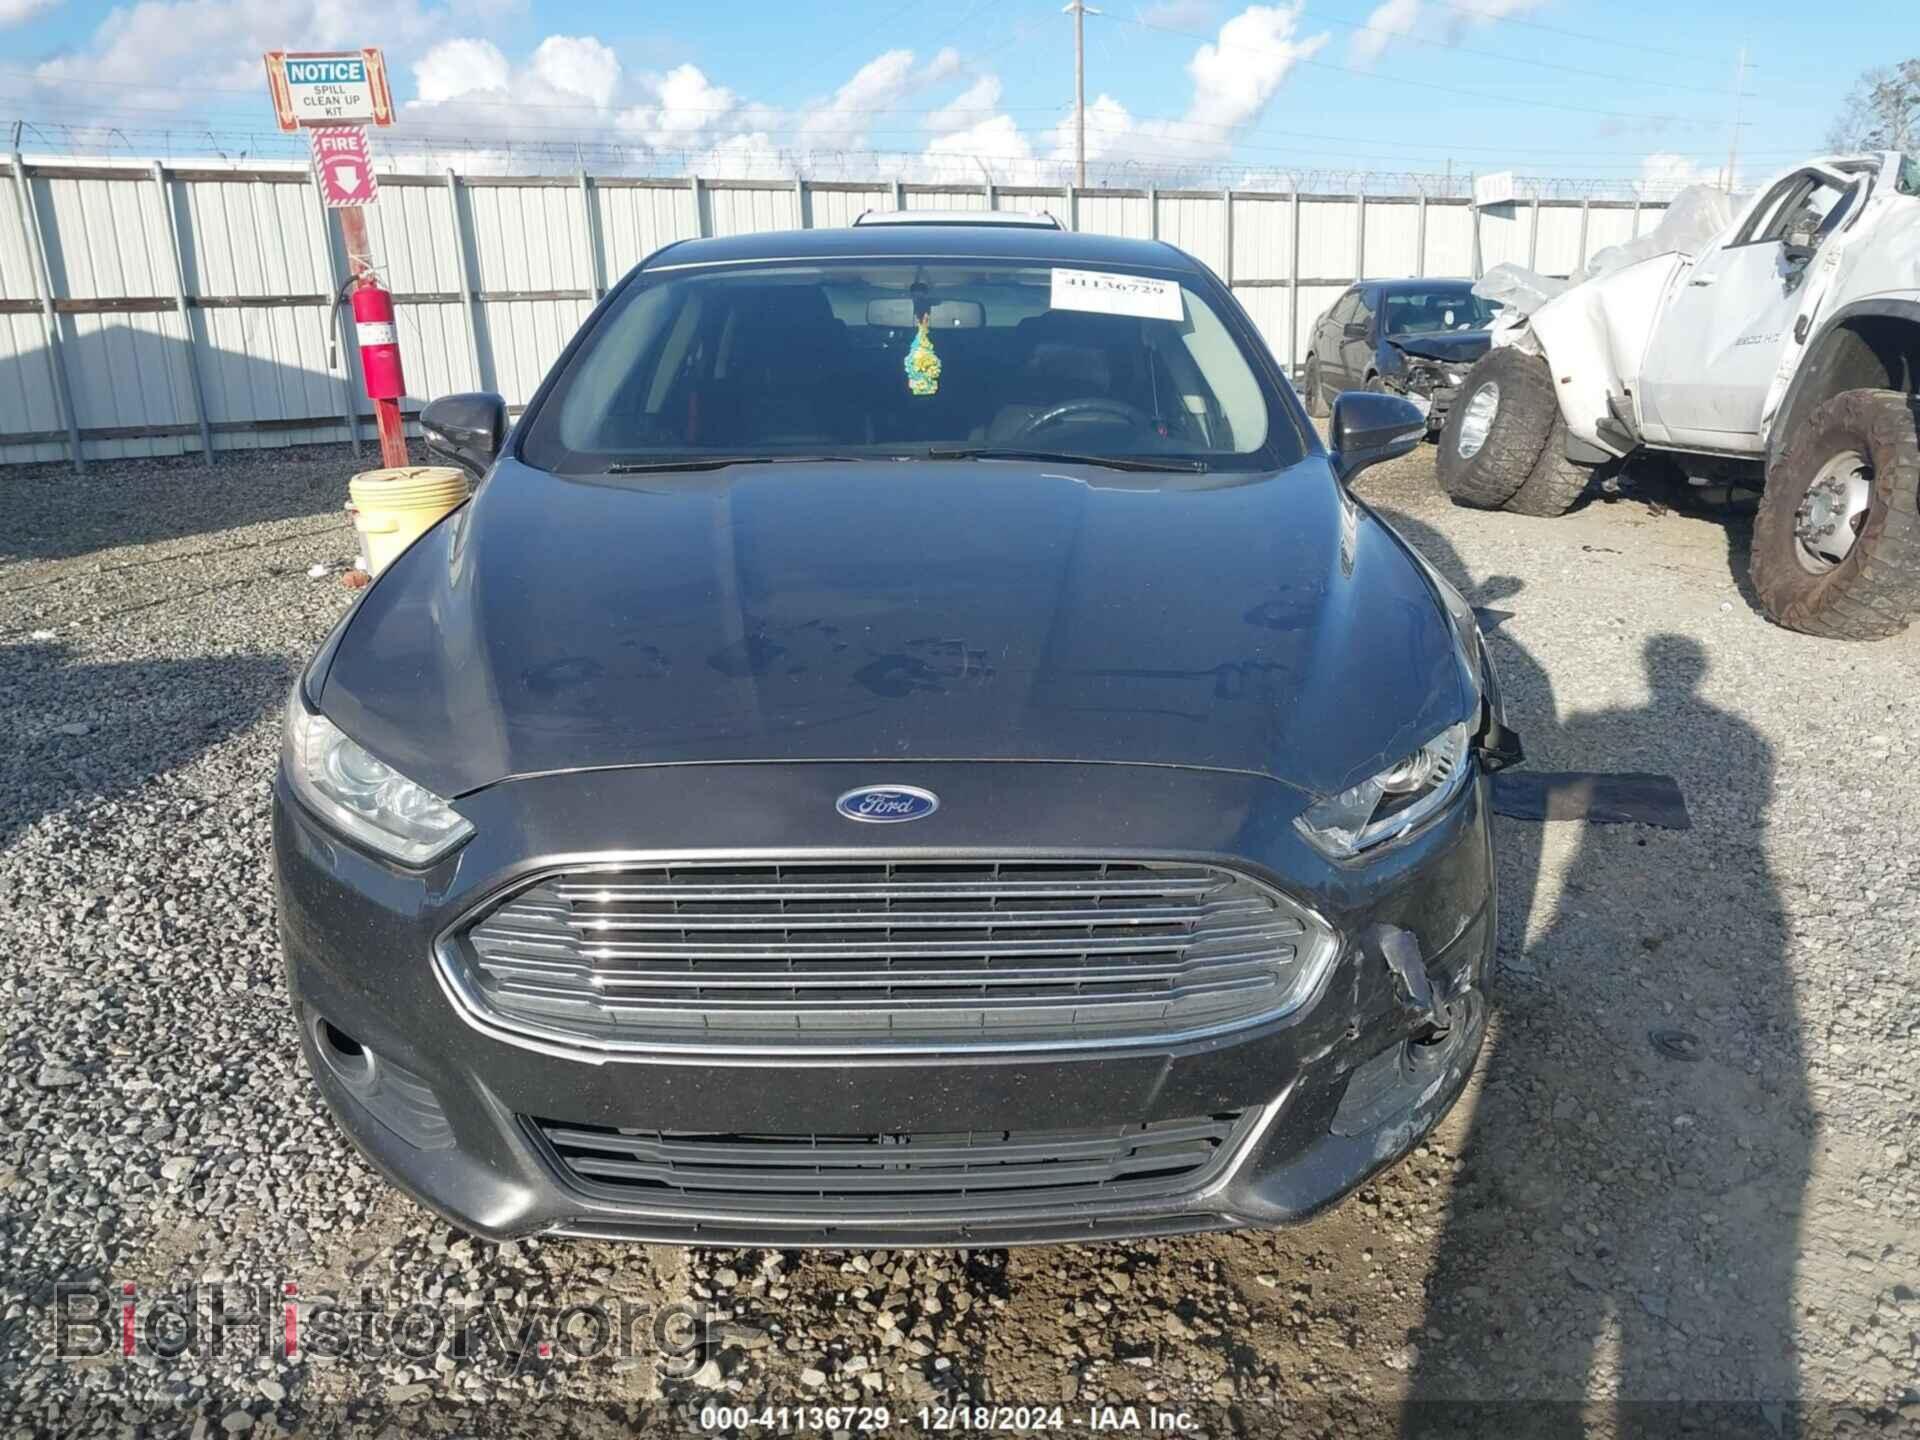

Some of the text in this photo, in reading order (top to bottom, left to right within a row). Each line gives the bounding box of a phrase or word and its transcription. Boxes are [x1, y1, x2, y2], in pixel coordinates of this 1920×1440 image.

[291, 62, 361, 81] NOTICE
[314, 85, 346, 95] SPILL
[303, 95, 360, 106] CLEAN UP
[325, 107, 343, 117] KIT
[321, 137, 359, 150] FIRE
[1064, 278, 1165, 294] 41136729
[859, 793, 914, 813] Ford
